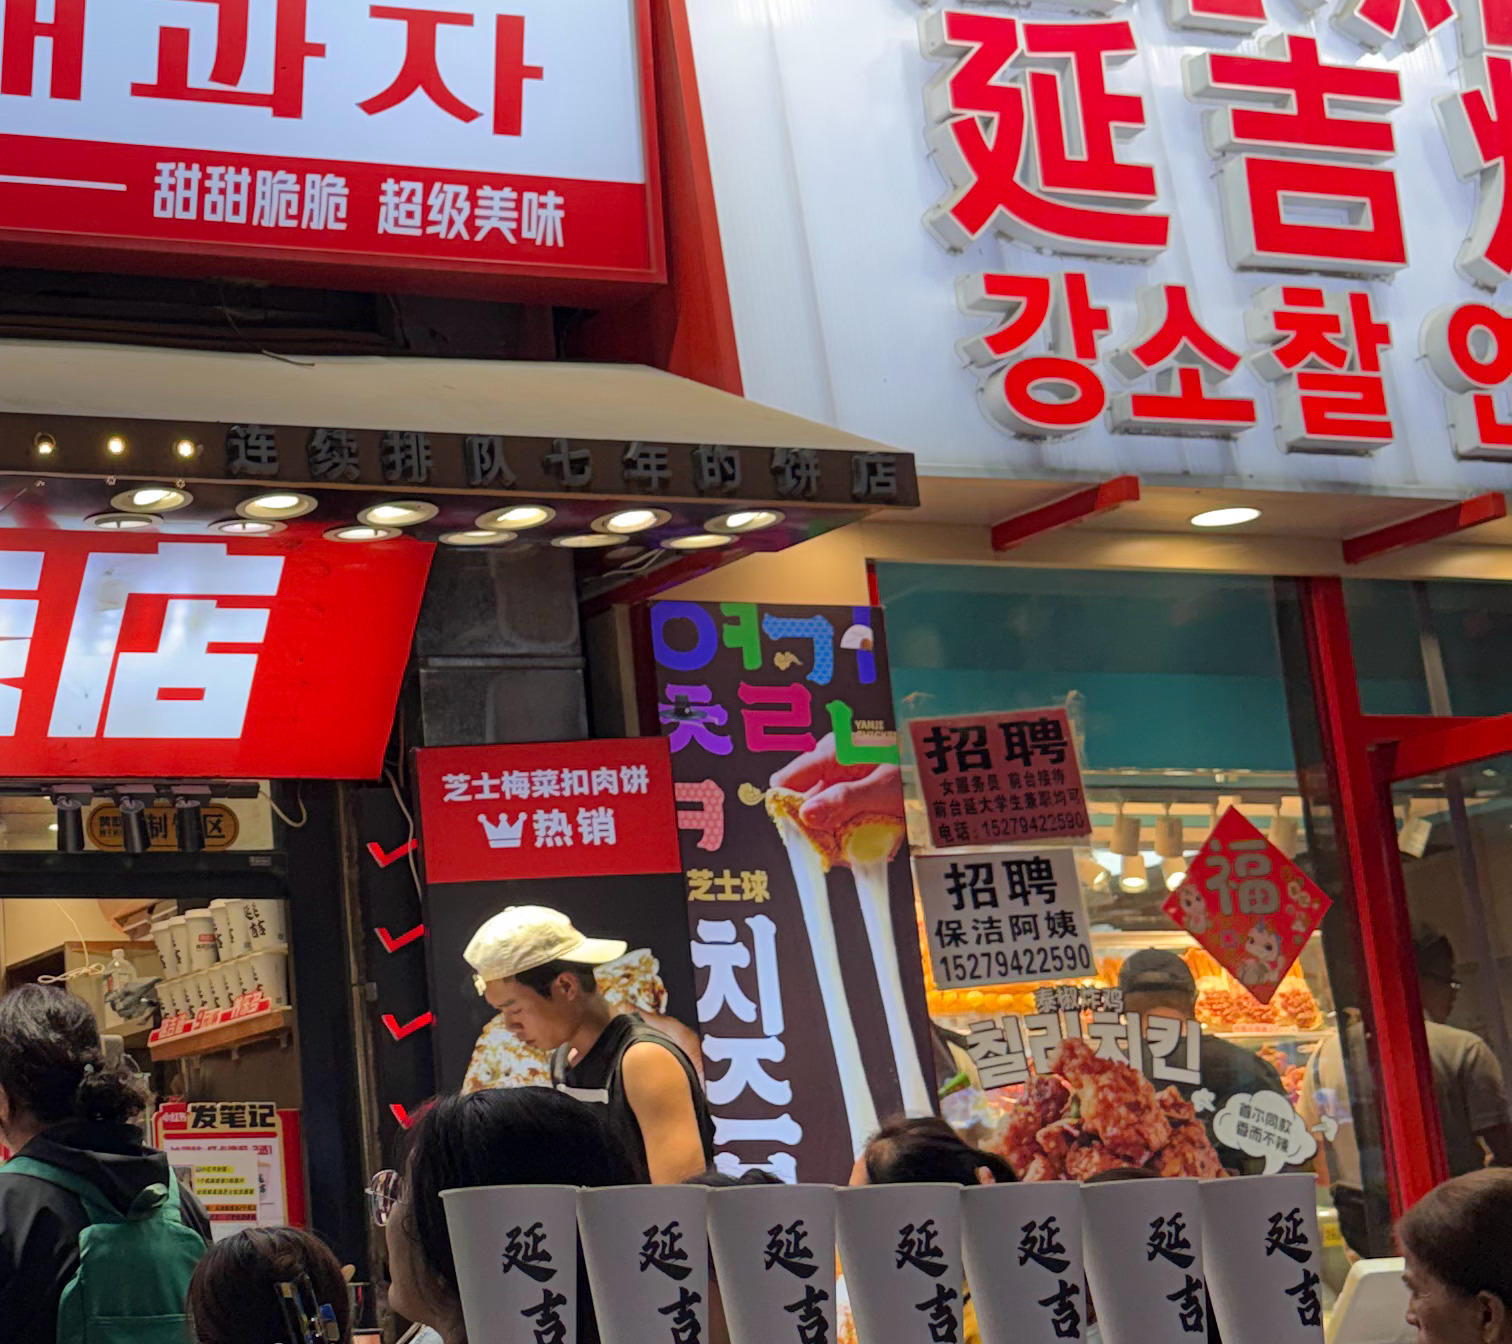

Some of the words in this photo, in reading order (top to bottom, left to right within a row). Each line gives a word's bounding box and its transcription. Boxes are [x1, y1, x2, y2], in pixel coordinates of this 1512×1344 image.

[938, 8, 1512, 278] 延吉
[152, 161, 351, 231] 甜甜脆脆
[378, 177, 566, 248] 超级美味
[228, 422, 901, 501] 连续排队七年的饼店
[922, 718, 1068, 775] 招聘
[442, 764, 650, 803] 芝士梅菜扣肉饼
[533, 807, 617, 849] 热销
[686, 868, 771, 903] 芝士球
[943, 856, 1058, 911] 招聘
[1204, 839, 1281, 918] 福
[934, 909, 1079, 949] 保洁阿姨
[939, 943, 1091, 982] 15279422590
[191, 1103, 277, 1129] 发笔记
[1017, 1214, 1082, 1341] 延吉
[1147, 1211, 1205, 1334] 延吉
[1264, 1206, 1323, 1329] 延吉
